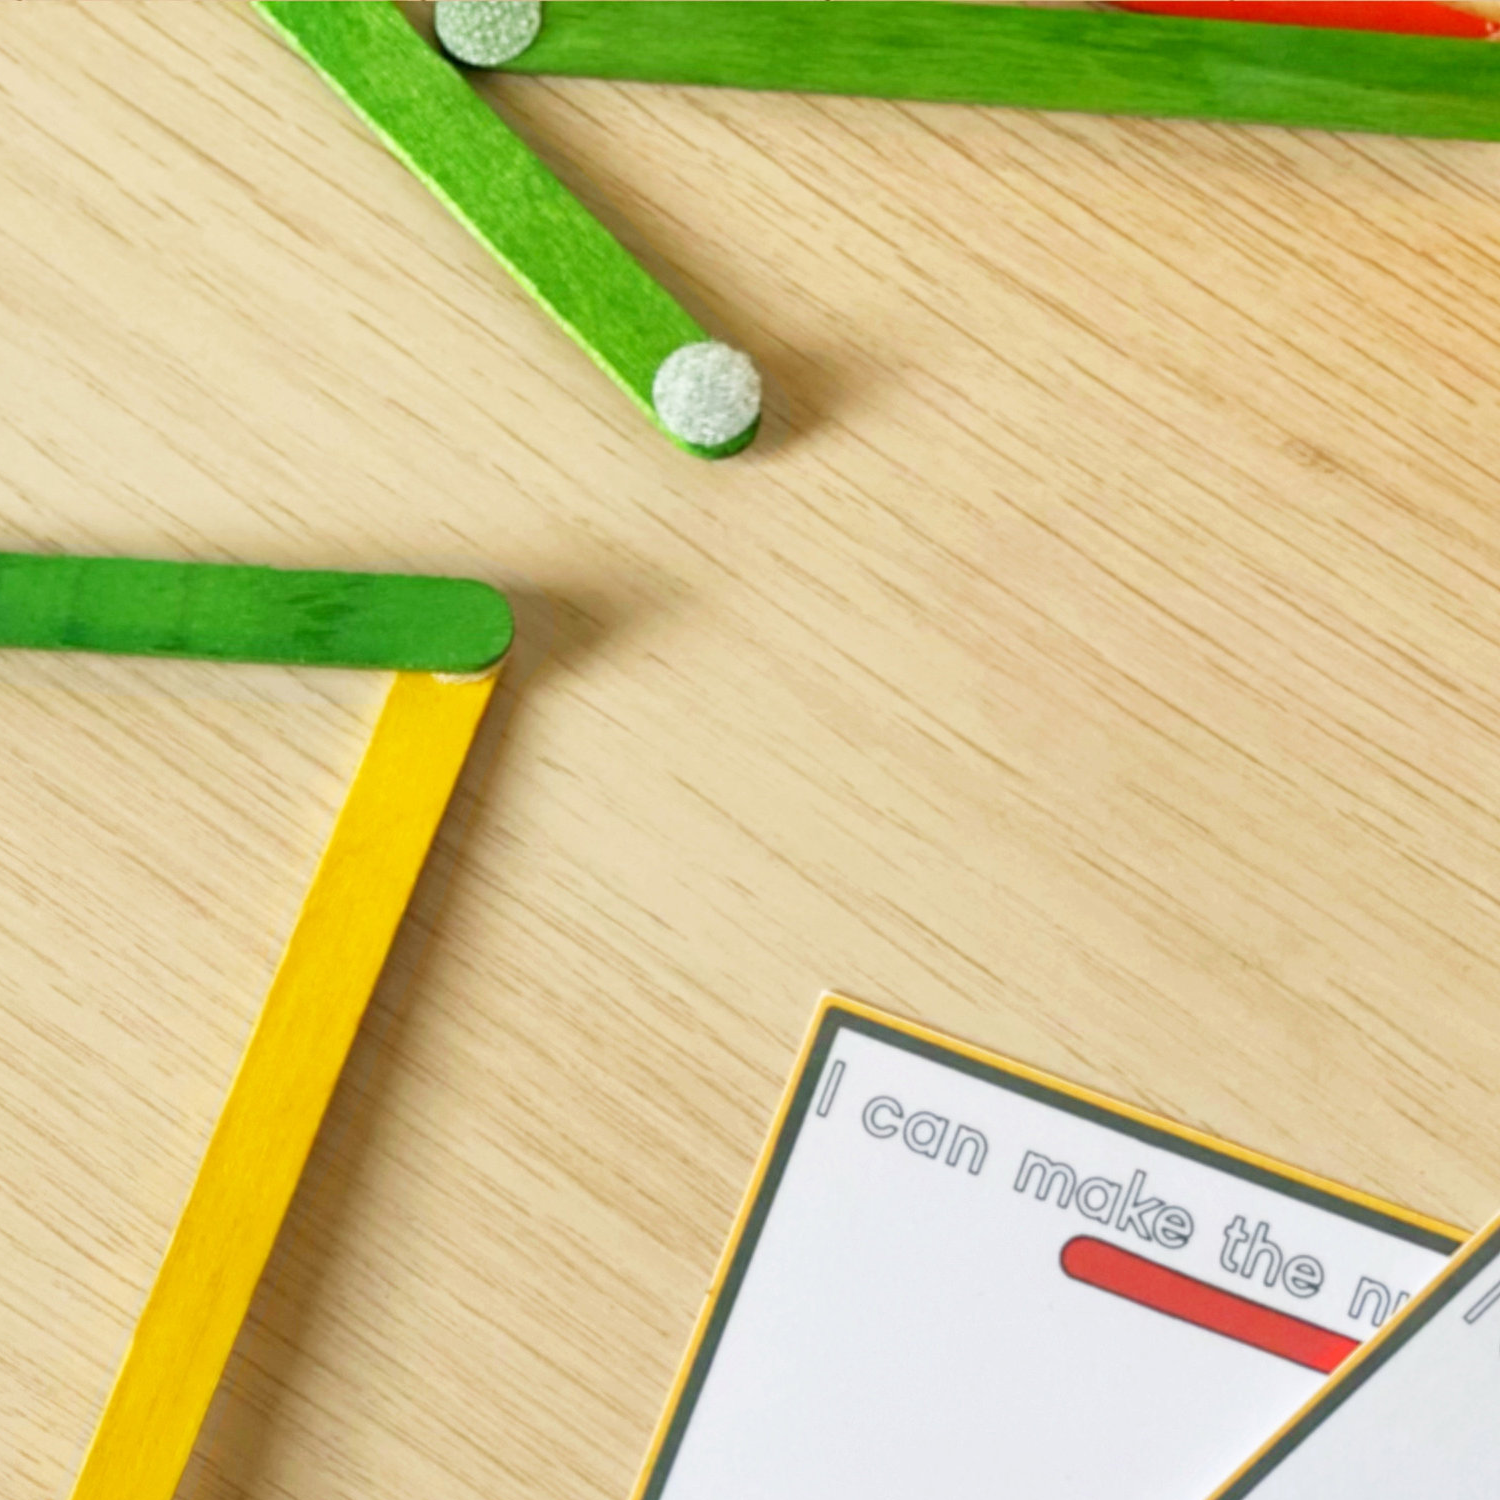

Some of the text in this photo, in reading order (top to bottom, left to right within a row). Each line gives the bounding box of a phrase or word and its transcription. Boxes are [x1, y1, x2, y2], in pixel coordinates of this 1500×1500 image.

[816, 1060, 1325, 1299] I can make the
